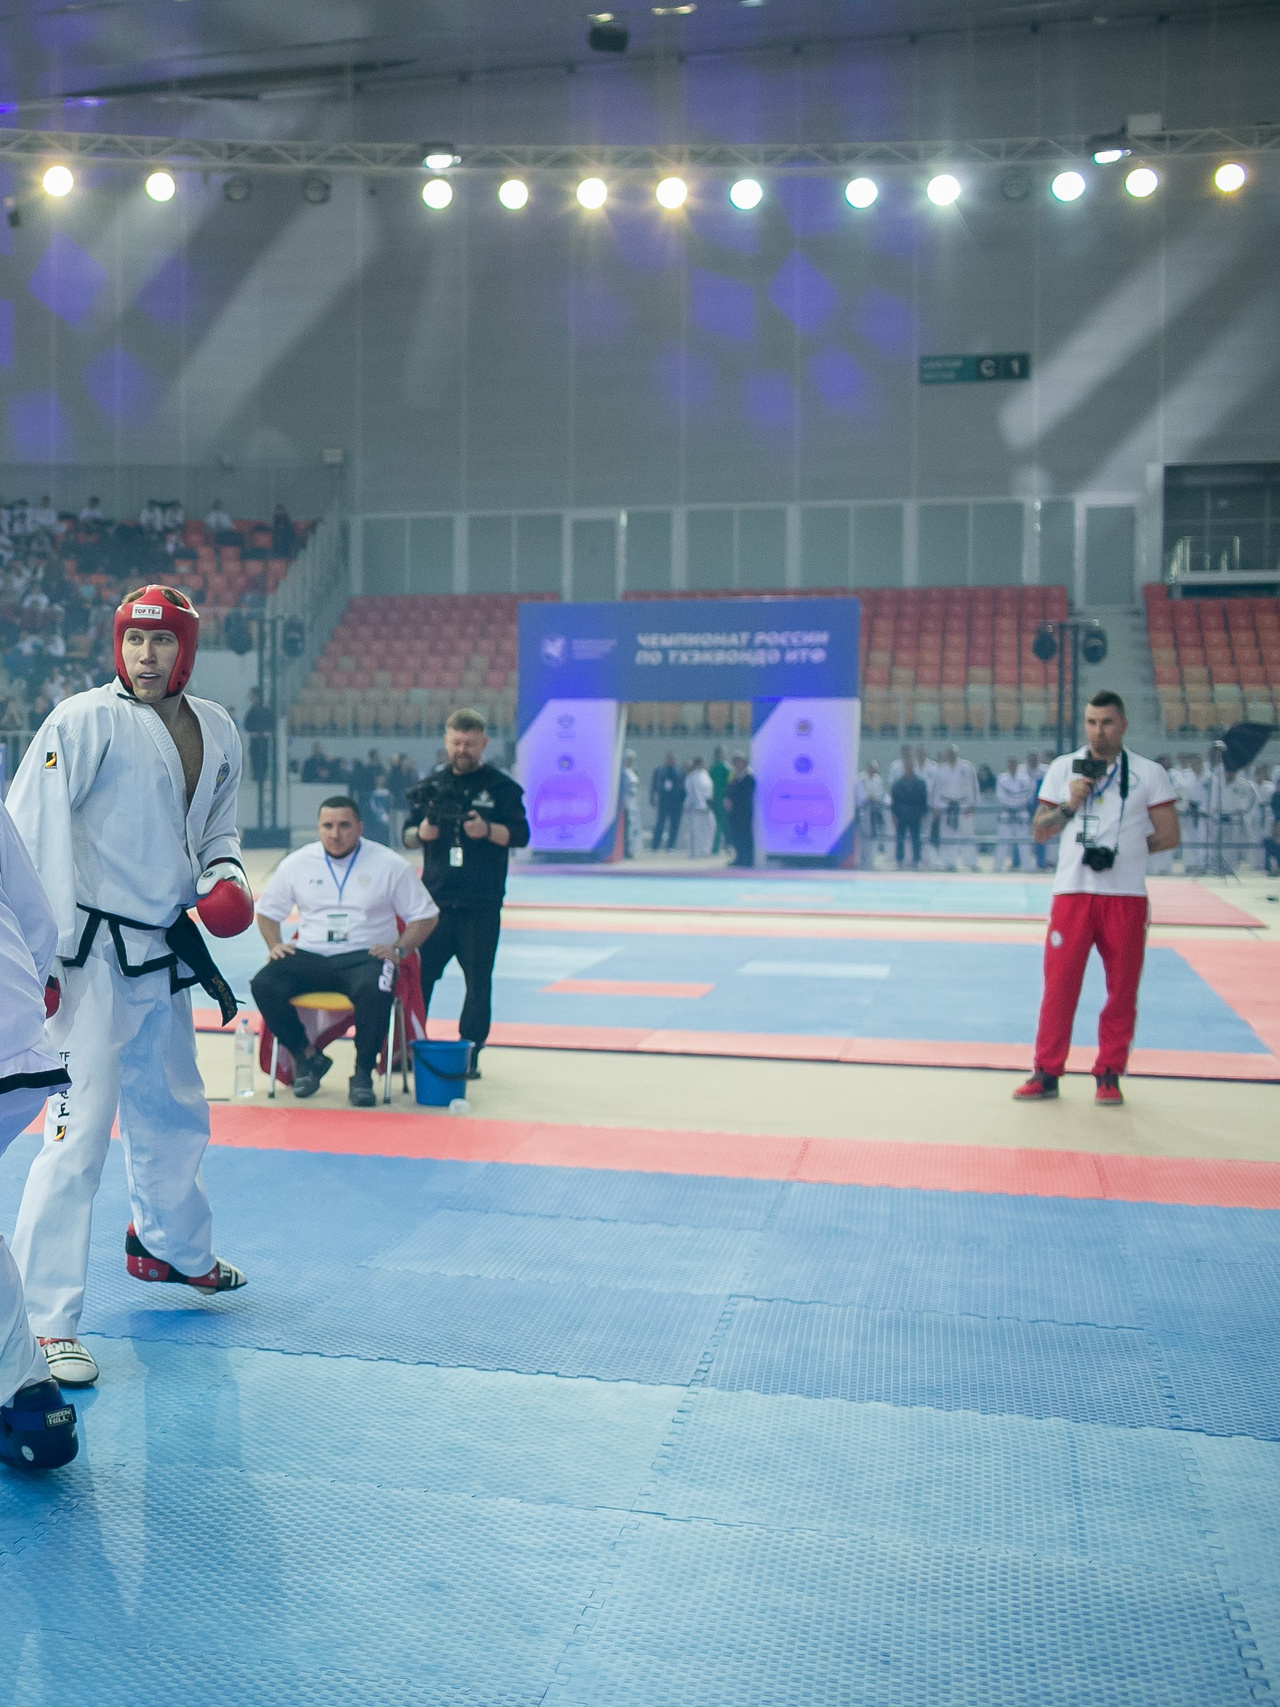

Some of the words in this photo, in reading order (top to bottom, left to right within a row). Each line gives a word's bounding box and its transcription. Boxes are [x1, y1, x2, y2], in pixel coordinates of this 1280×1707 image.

[637, 632, 751, 648] ЧЕМПИОНАТ
[754, 631, 830, 647] РОССИИ
[635, 649, 663, 667] ПО
[785, 648, 827, 665] ИТФ
